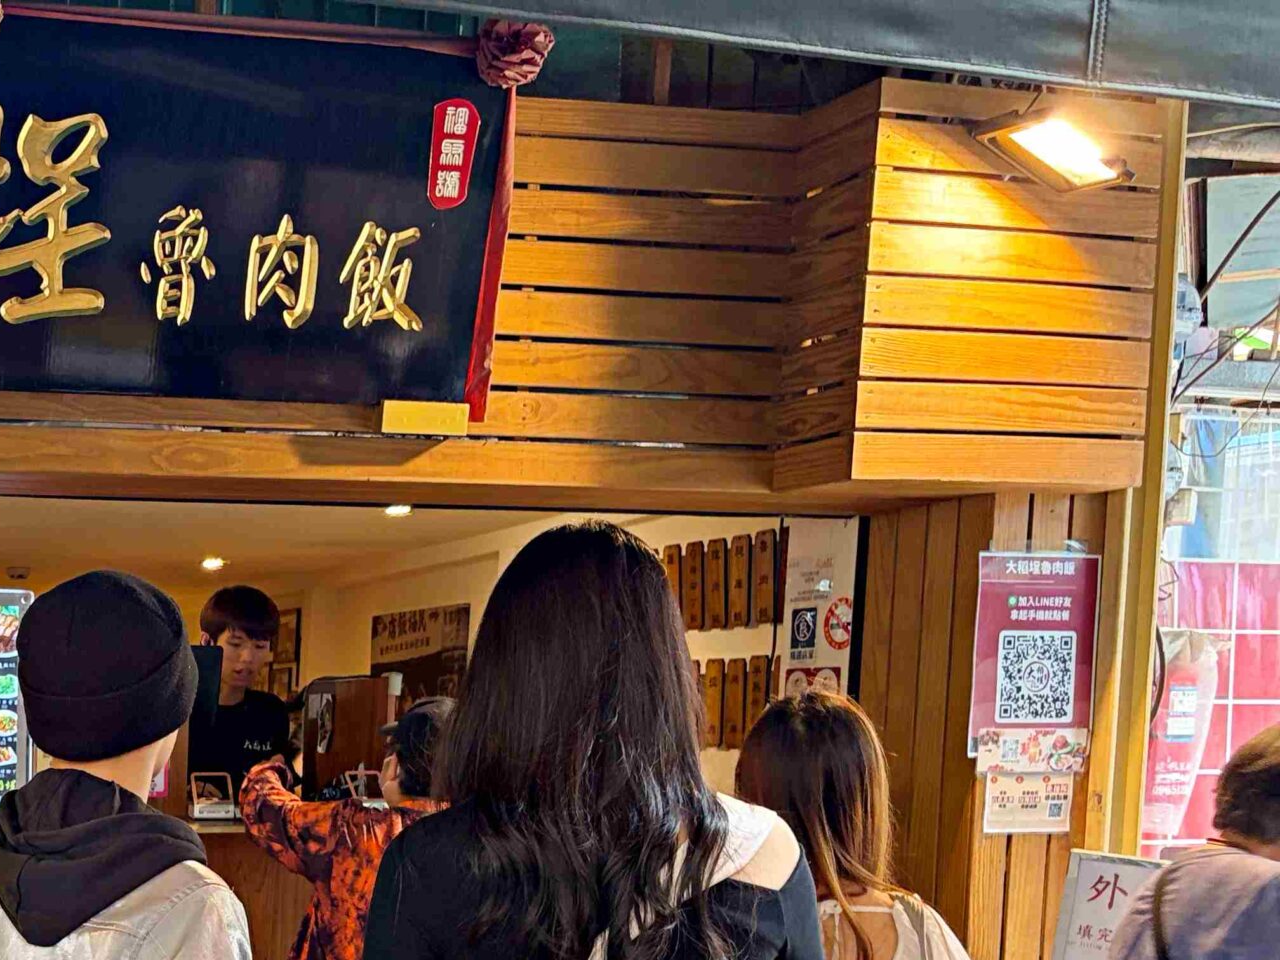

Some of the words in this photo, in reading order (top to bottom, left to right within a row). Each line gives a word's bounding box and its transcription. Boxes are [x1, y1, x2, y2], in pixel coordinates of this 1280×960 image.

[1005, 559, 1076, 576] 大稻埕魯肉飯
